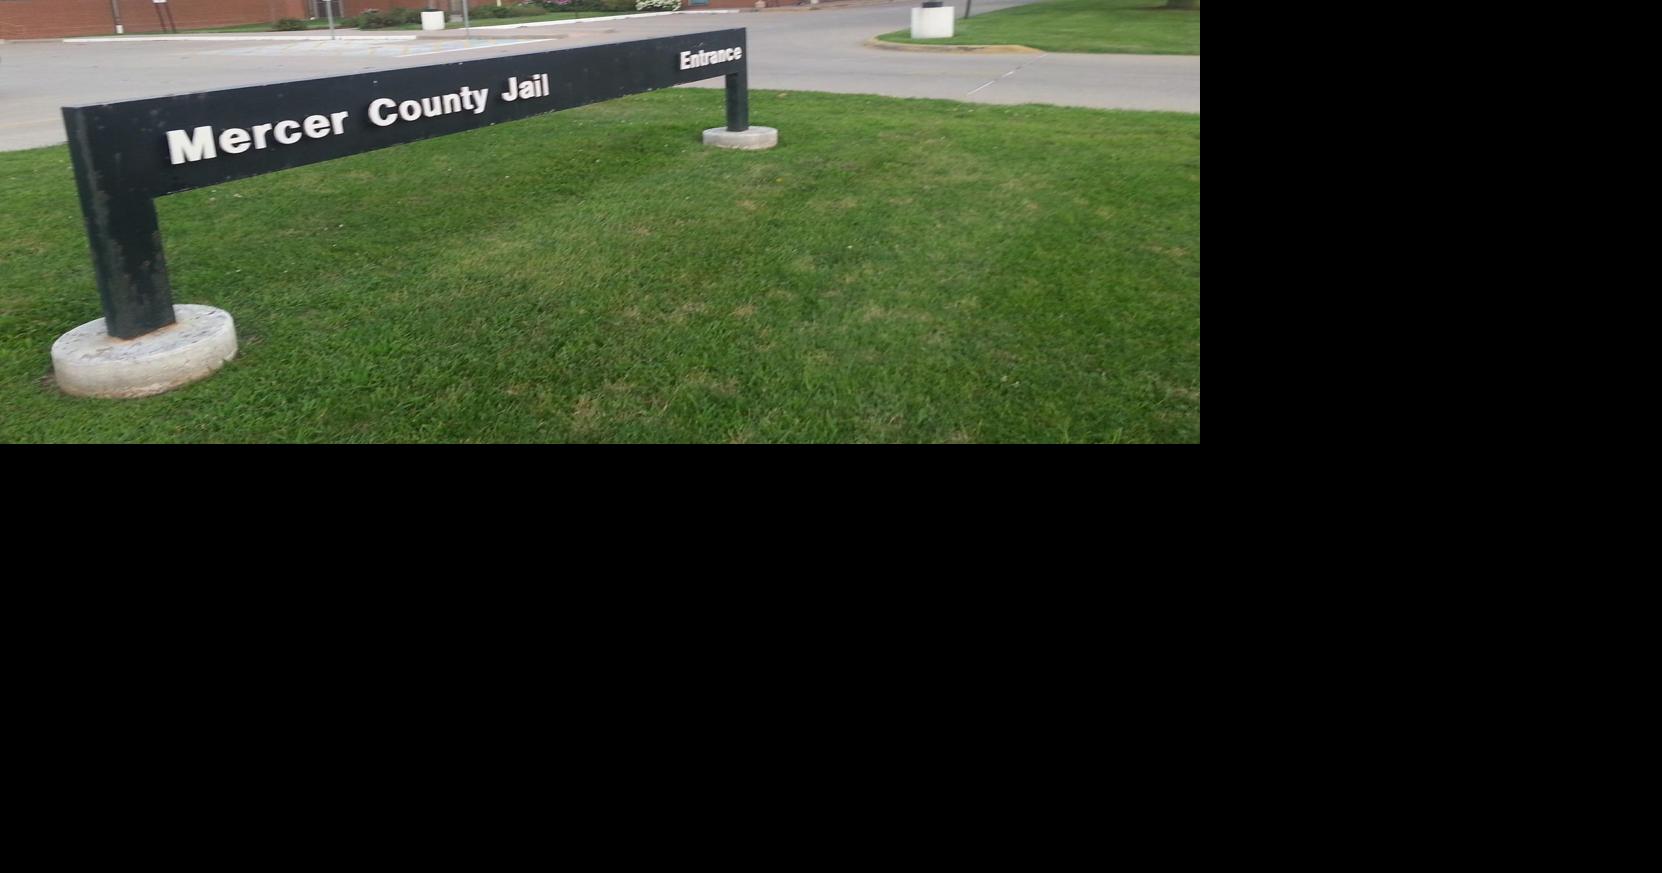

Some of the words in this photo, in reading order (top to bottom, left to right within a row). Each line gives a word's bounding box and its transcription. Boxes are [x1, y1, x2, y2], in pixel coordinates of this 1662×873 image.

[680, 46, 743, 70] Entrance
[166, 110, 348, 165] Mercer
[368, 86, 488, 127] County
[501, 73, 550, 102] Jail
